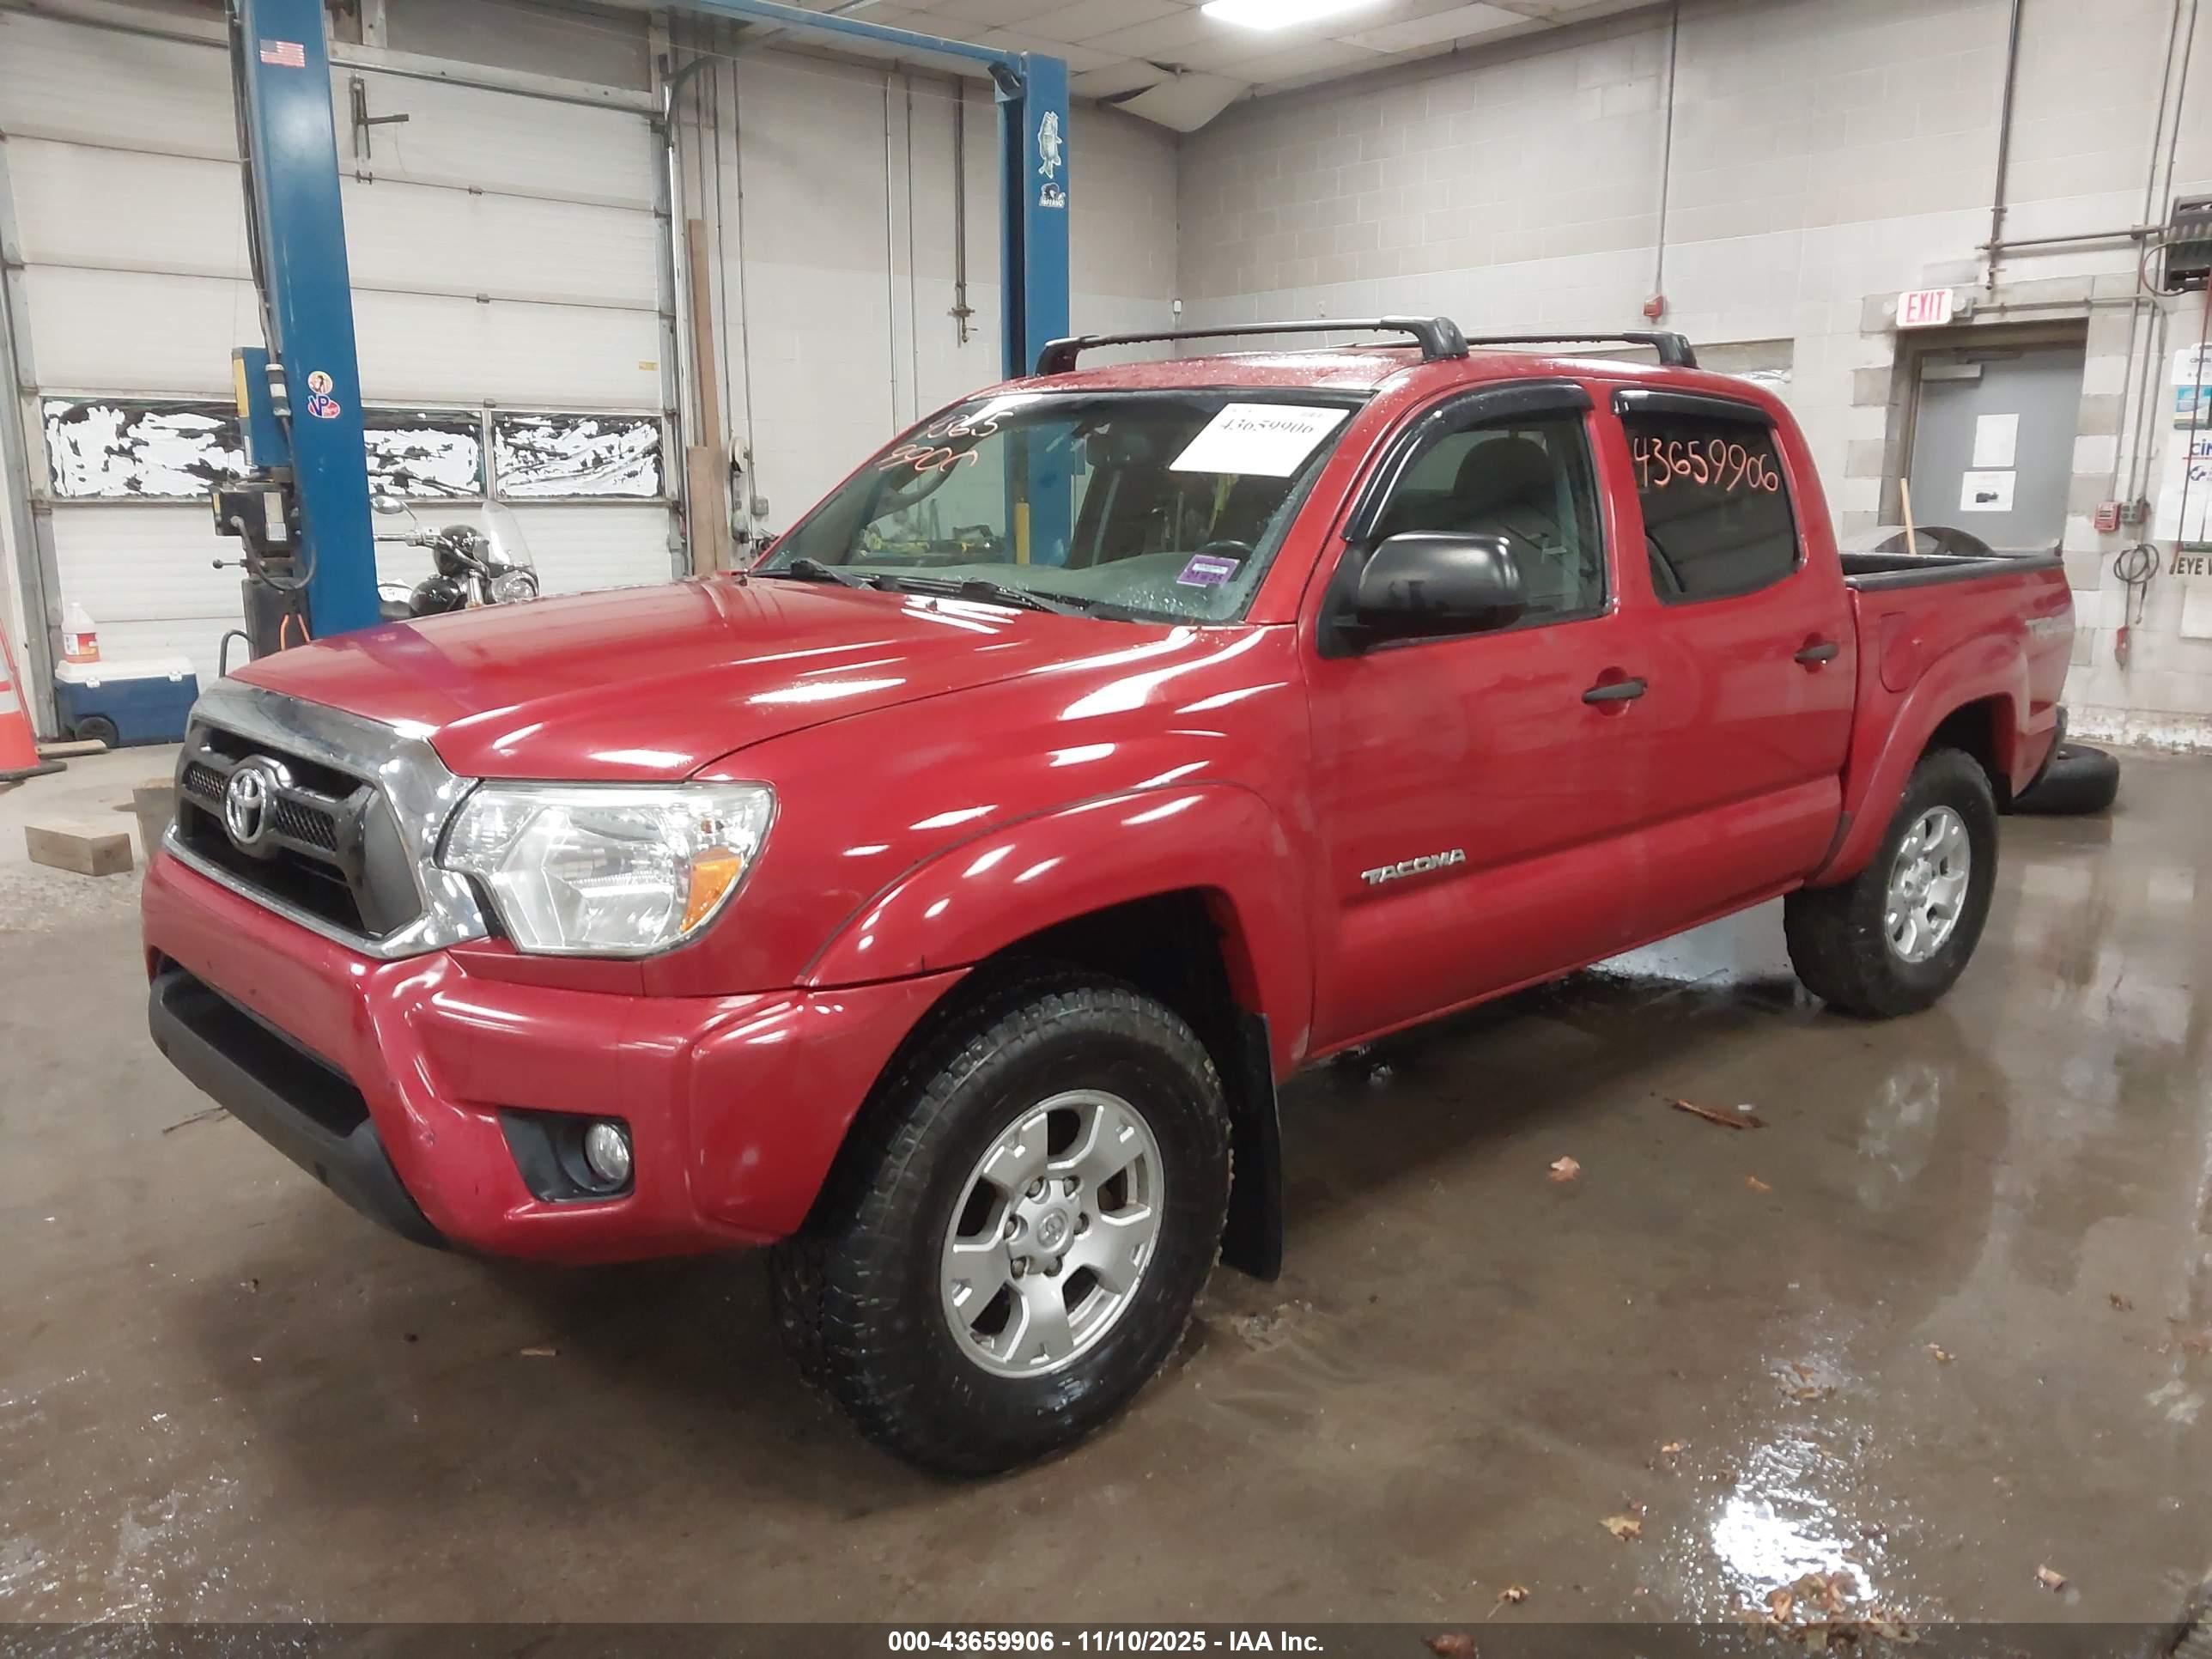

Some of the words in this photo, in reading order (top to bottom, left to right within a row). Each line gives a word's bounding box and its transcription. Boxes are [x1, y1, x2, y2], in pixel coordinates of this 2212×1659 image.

[1906, 291, 1945, 322] EXIT
[1633, 437, 1779, 492] 43659906
[2177, 556, 2203, 575] EYE
[1361, 848, 1466, 884] TACOMA
